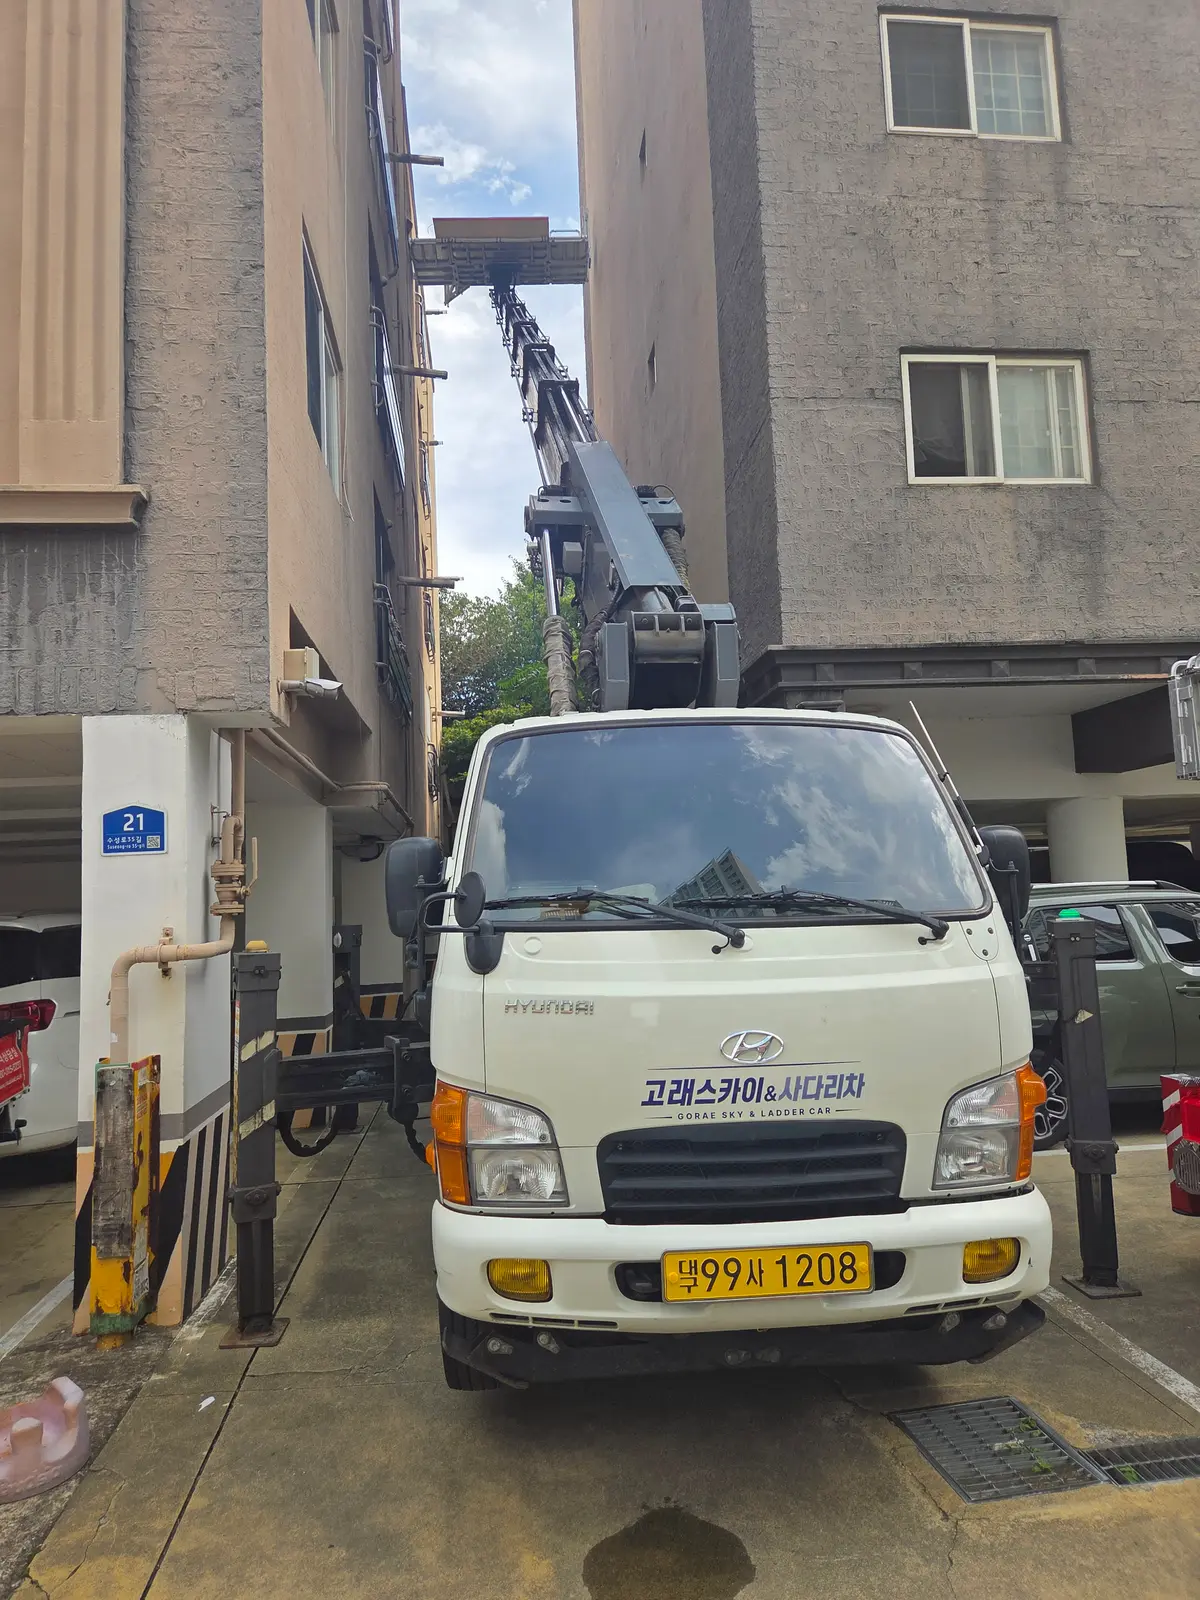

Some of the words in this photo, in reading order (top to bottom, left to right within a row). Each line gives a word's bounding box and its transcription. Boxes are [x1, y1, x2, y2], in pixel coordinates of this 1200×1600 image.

[123, 813, 144, 831] 21
[107, 836, 142, 844] 수성로35길
[504, 999, 594, 1015] HYUNDAI
[677, 1111, 717, 1120] GORAE
[721, 1110, 744, 1119] SKY
[749, 1110, 756, 1118] &
[761, 1108, 805, 1118] LADDER
[809, 1107, 832, 1116] CAR
[775, 1251, 858, 1288] 1208
